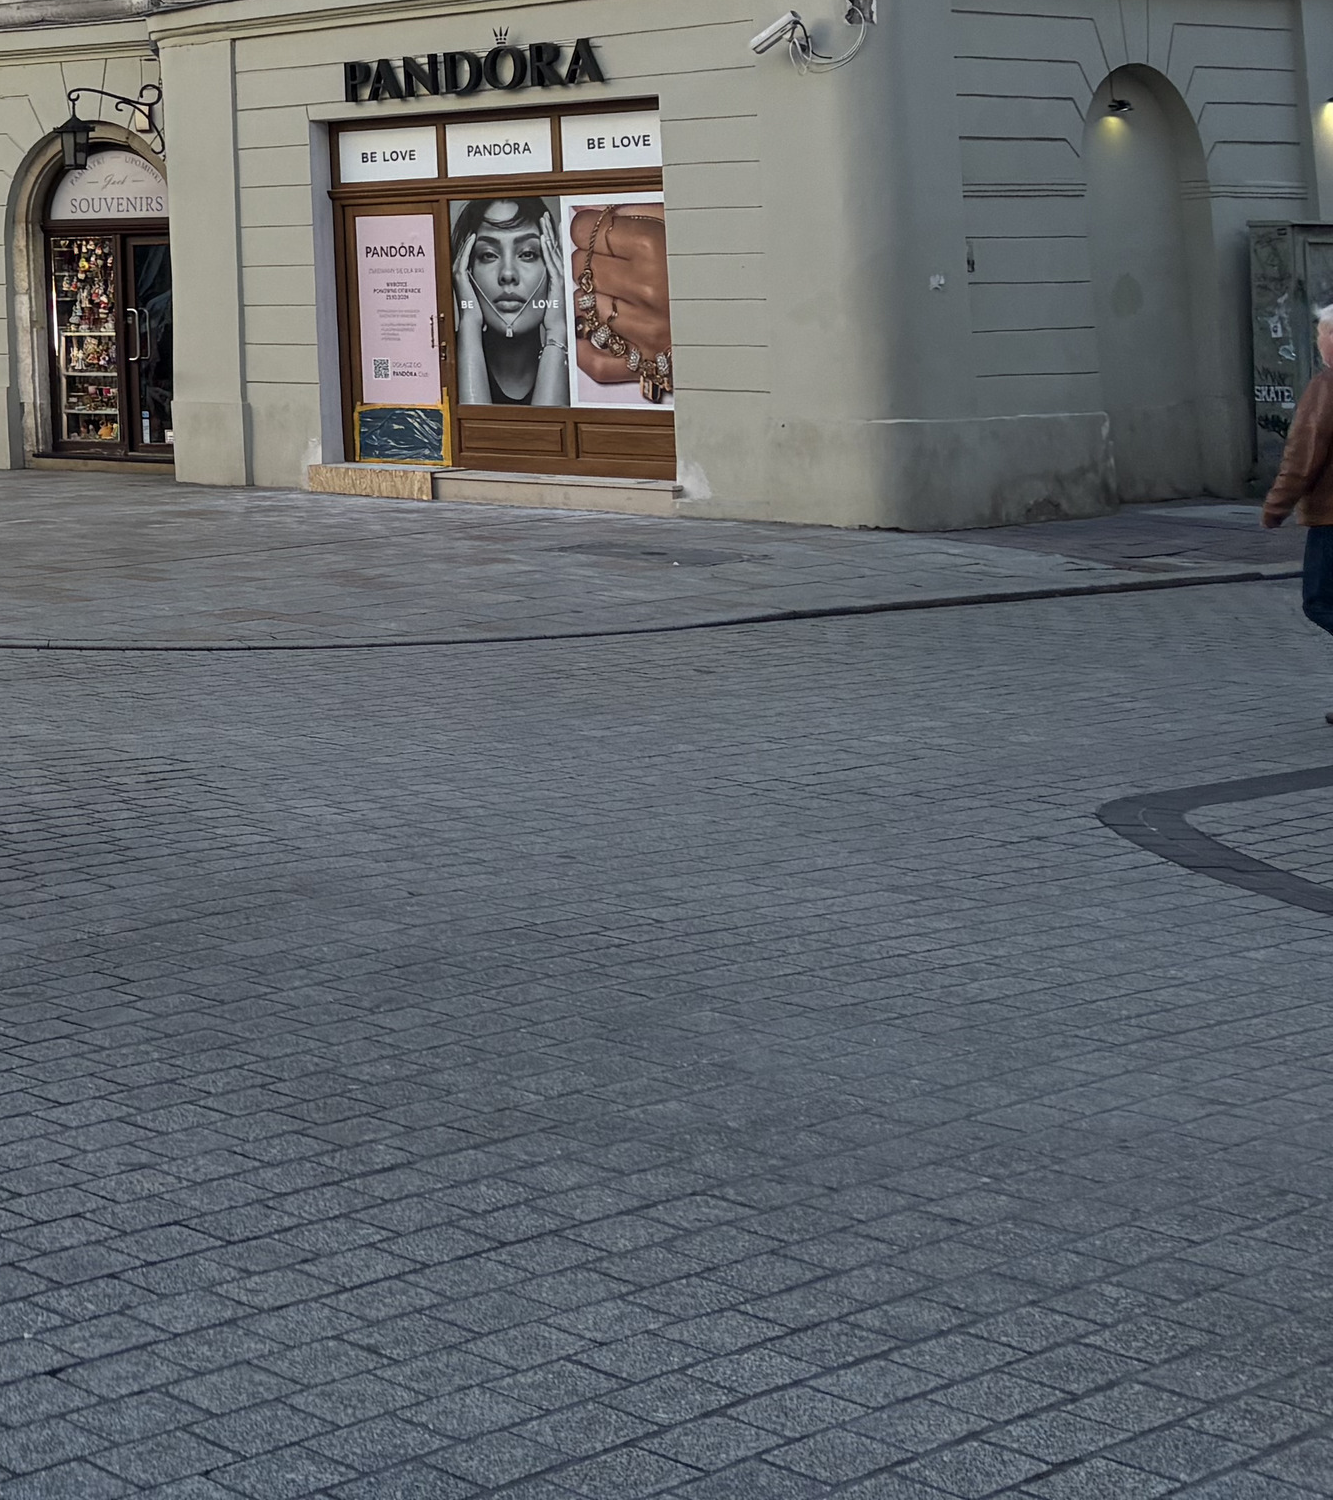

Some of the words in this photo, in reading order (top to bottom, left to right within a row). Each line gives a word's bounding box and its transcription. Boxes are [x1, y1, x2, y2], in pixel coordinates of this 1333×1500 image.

[344, 38, 605, 102] PANDORA
[467, 141, 532, 157] PANDORA
[587, 137, 606, 150] BE
[612, 134, 651, 148] LOVE
[361, 151, 377, 163] BE
[383, 149, 416, 162] LOVE
[125, 155, 163, 184] UPOMINKI
[70, 196, 164, 214] SOUVENIRS
[365, 244, 426, 258] PANDORA
[461, 300, 474, 309] BE
[532, 299, 559, 309] LOVE
